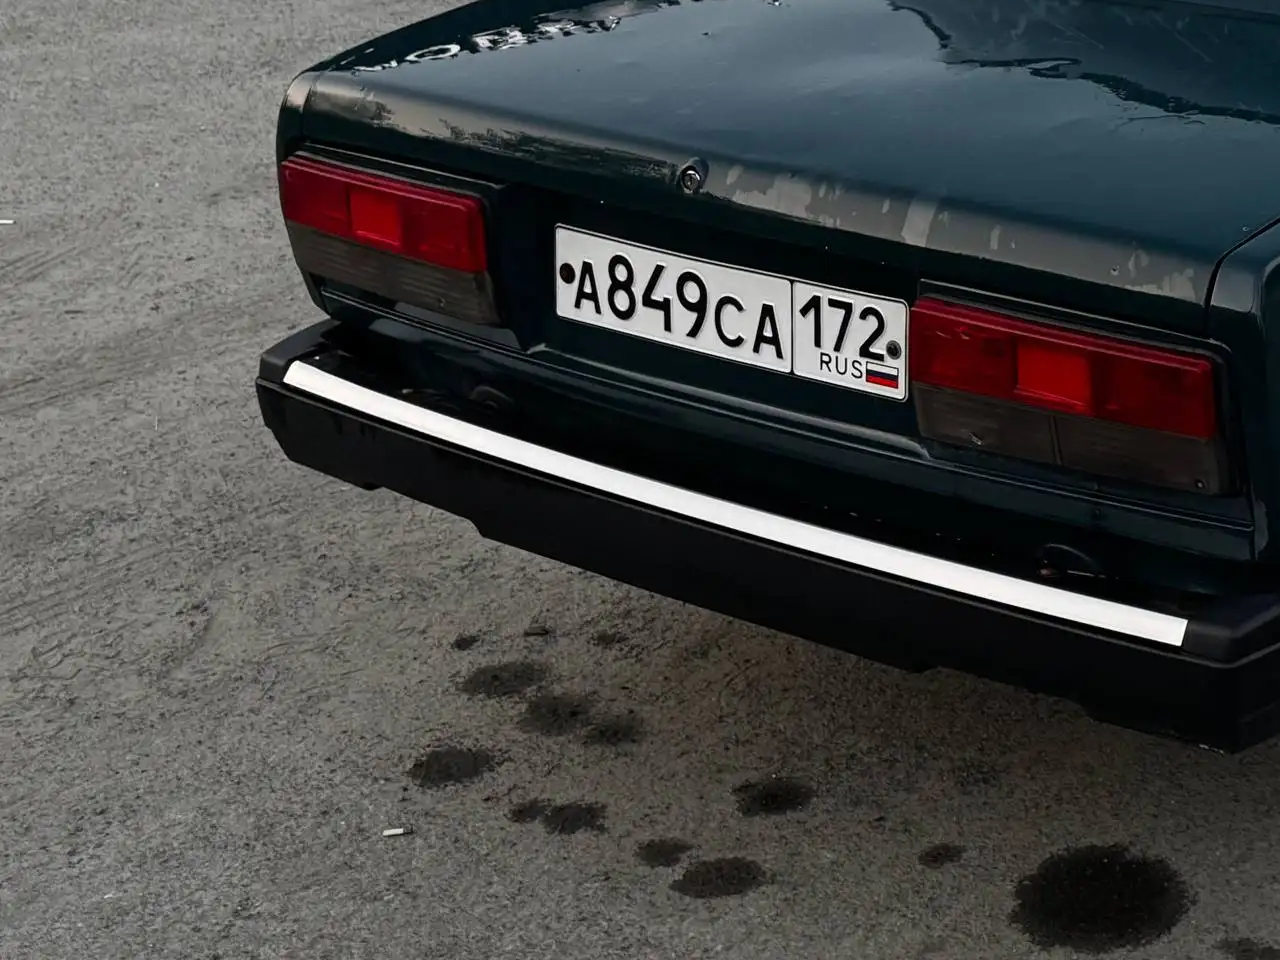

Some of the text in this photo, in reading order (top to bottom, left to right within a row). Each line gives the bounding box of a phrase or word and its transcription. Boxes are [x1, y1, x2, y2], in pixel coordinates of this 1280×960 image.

[574, 252, 886, 362] А849СА 172
[819, 351, 864, 380] RUS
